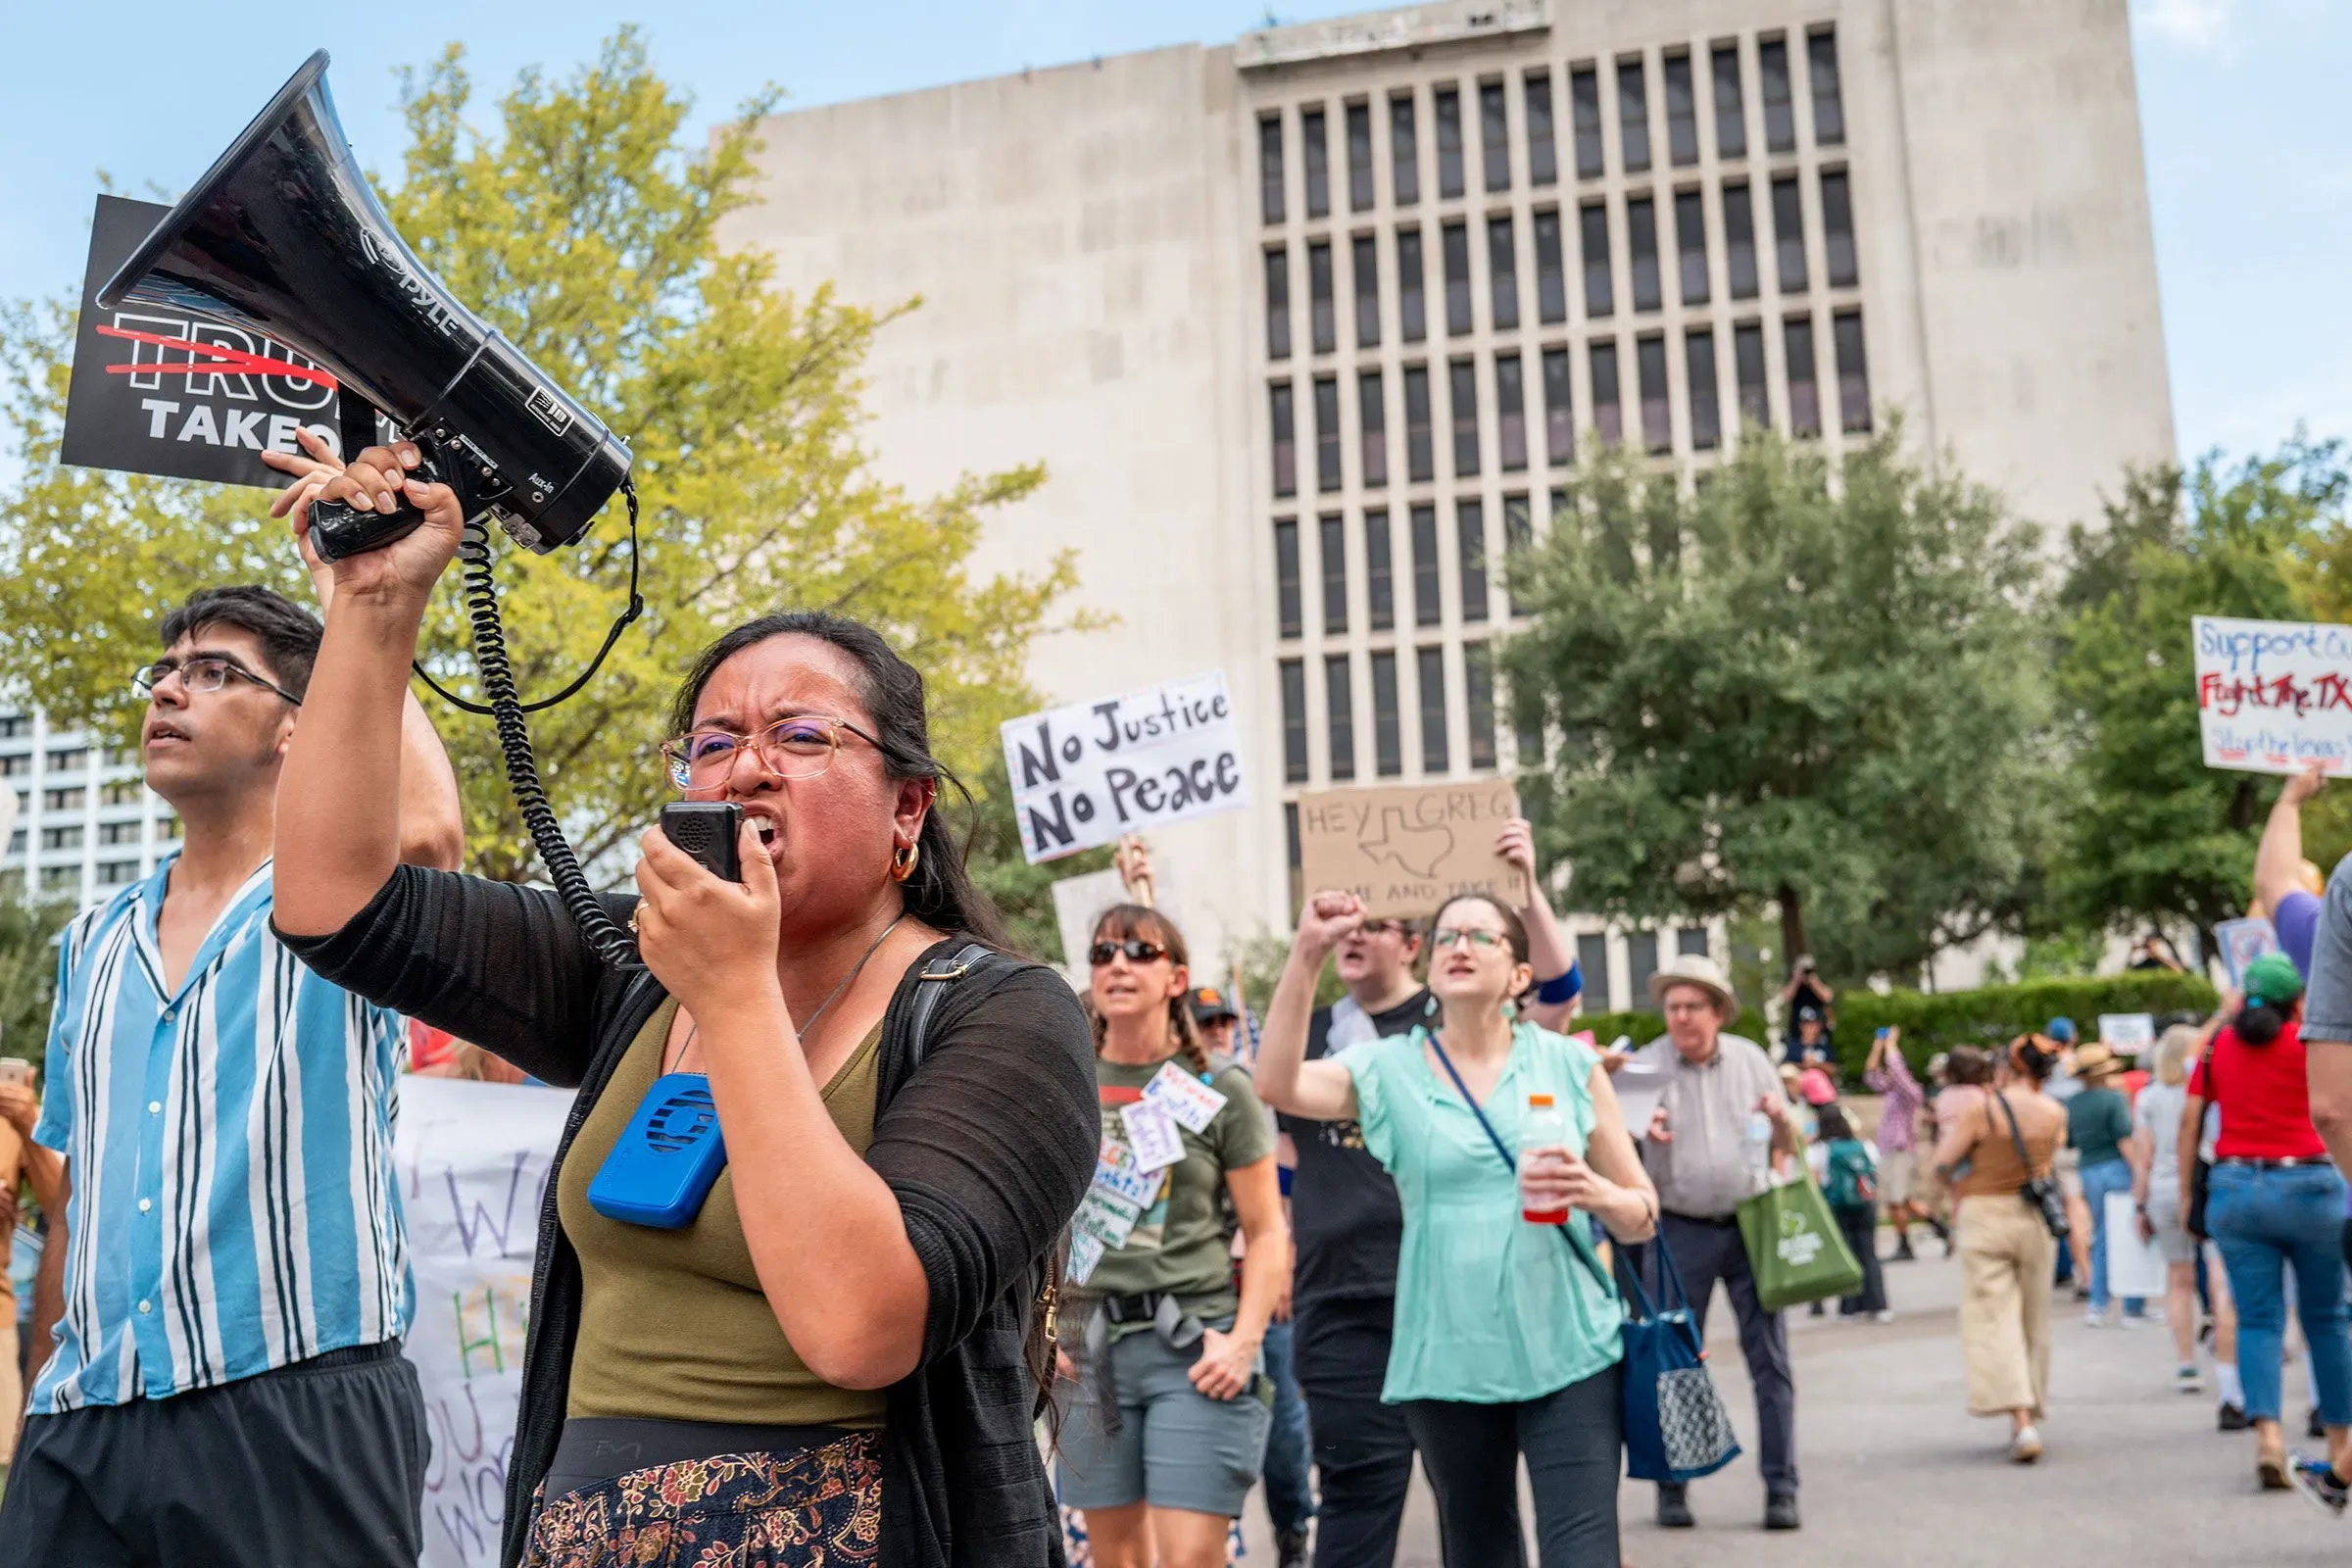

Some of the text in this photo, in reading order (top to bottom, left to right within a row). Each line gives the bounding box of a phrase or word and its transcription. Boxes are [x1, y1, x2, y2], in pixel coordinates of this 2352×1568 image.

[398, 273, 461, 337] PYLE
[114, 312, 402, 444] TRU
[2200, 621, 2323, 672] Support
[2199, 670, 2268, 717] Fight
[1019, 690, 1229, 788] No Justice
[1029, 752, 1240, 853] No Peace
[1306, 790, 1511, 839] HEY GREG
[1387, 884, 1436, 902] AND
